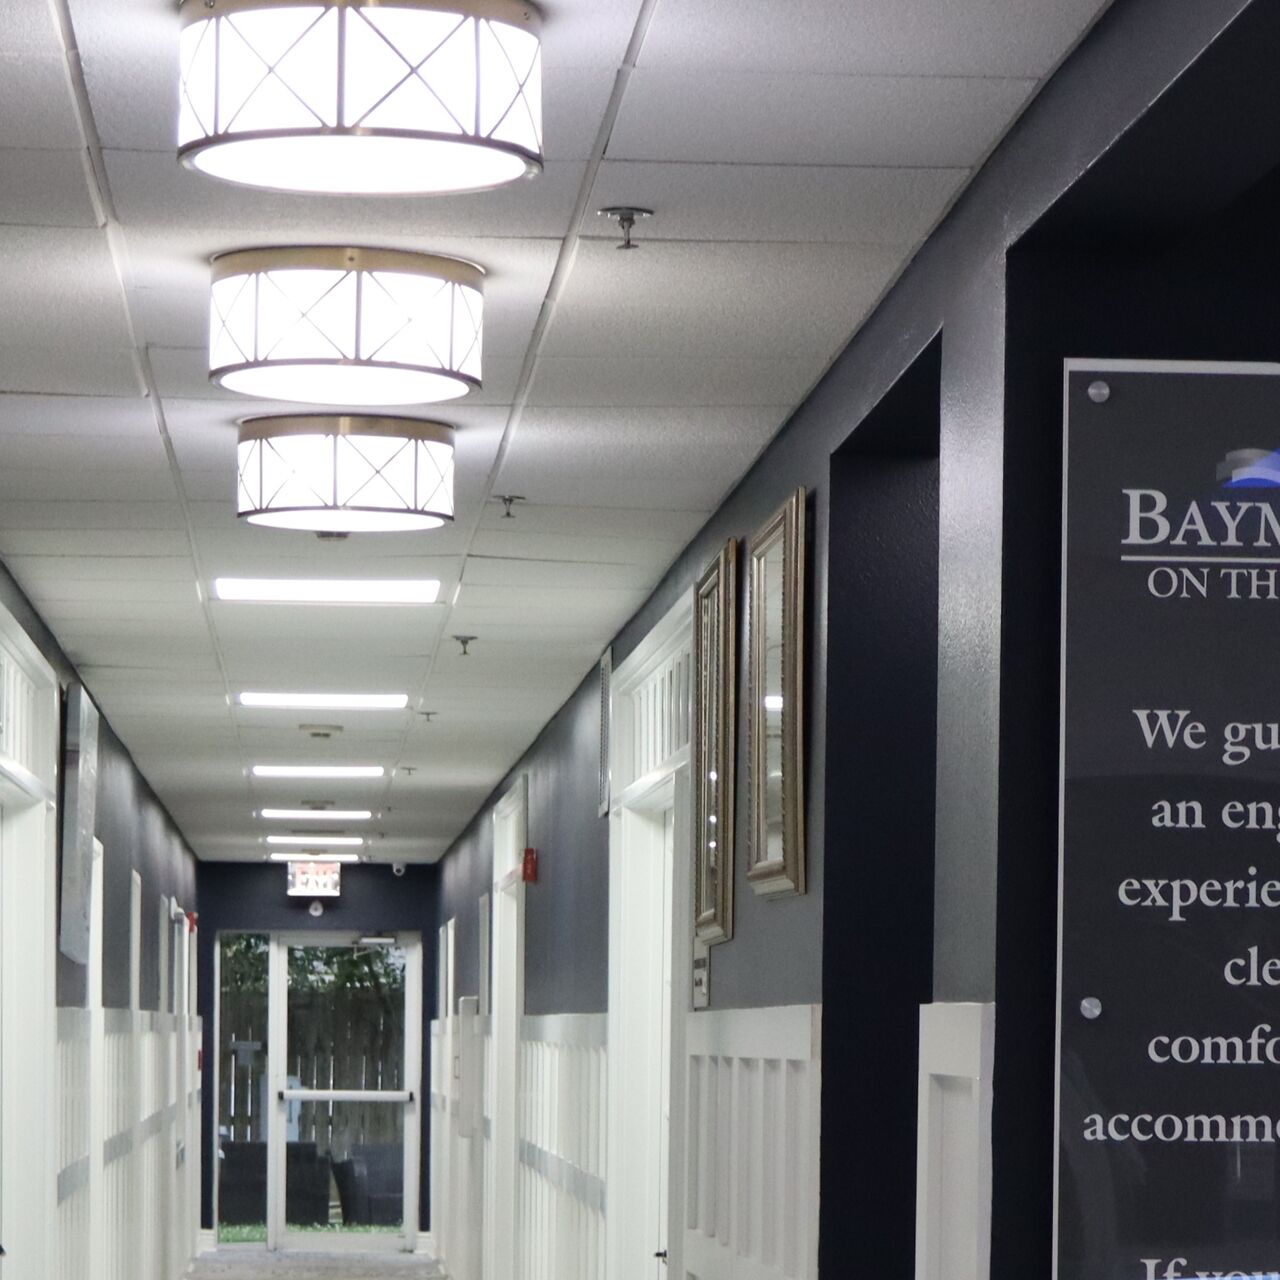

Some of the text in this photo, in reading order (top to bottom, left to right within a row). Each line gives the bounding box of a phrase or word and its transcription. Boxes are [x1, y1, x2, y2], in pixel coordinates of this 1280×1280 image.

[1146, 568, 1207, 598] ON
[1132, 709, 1207, 751] We
[1151, 799, 1206, 830] an
